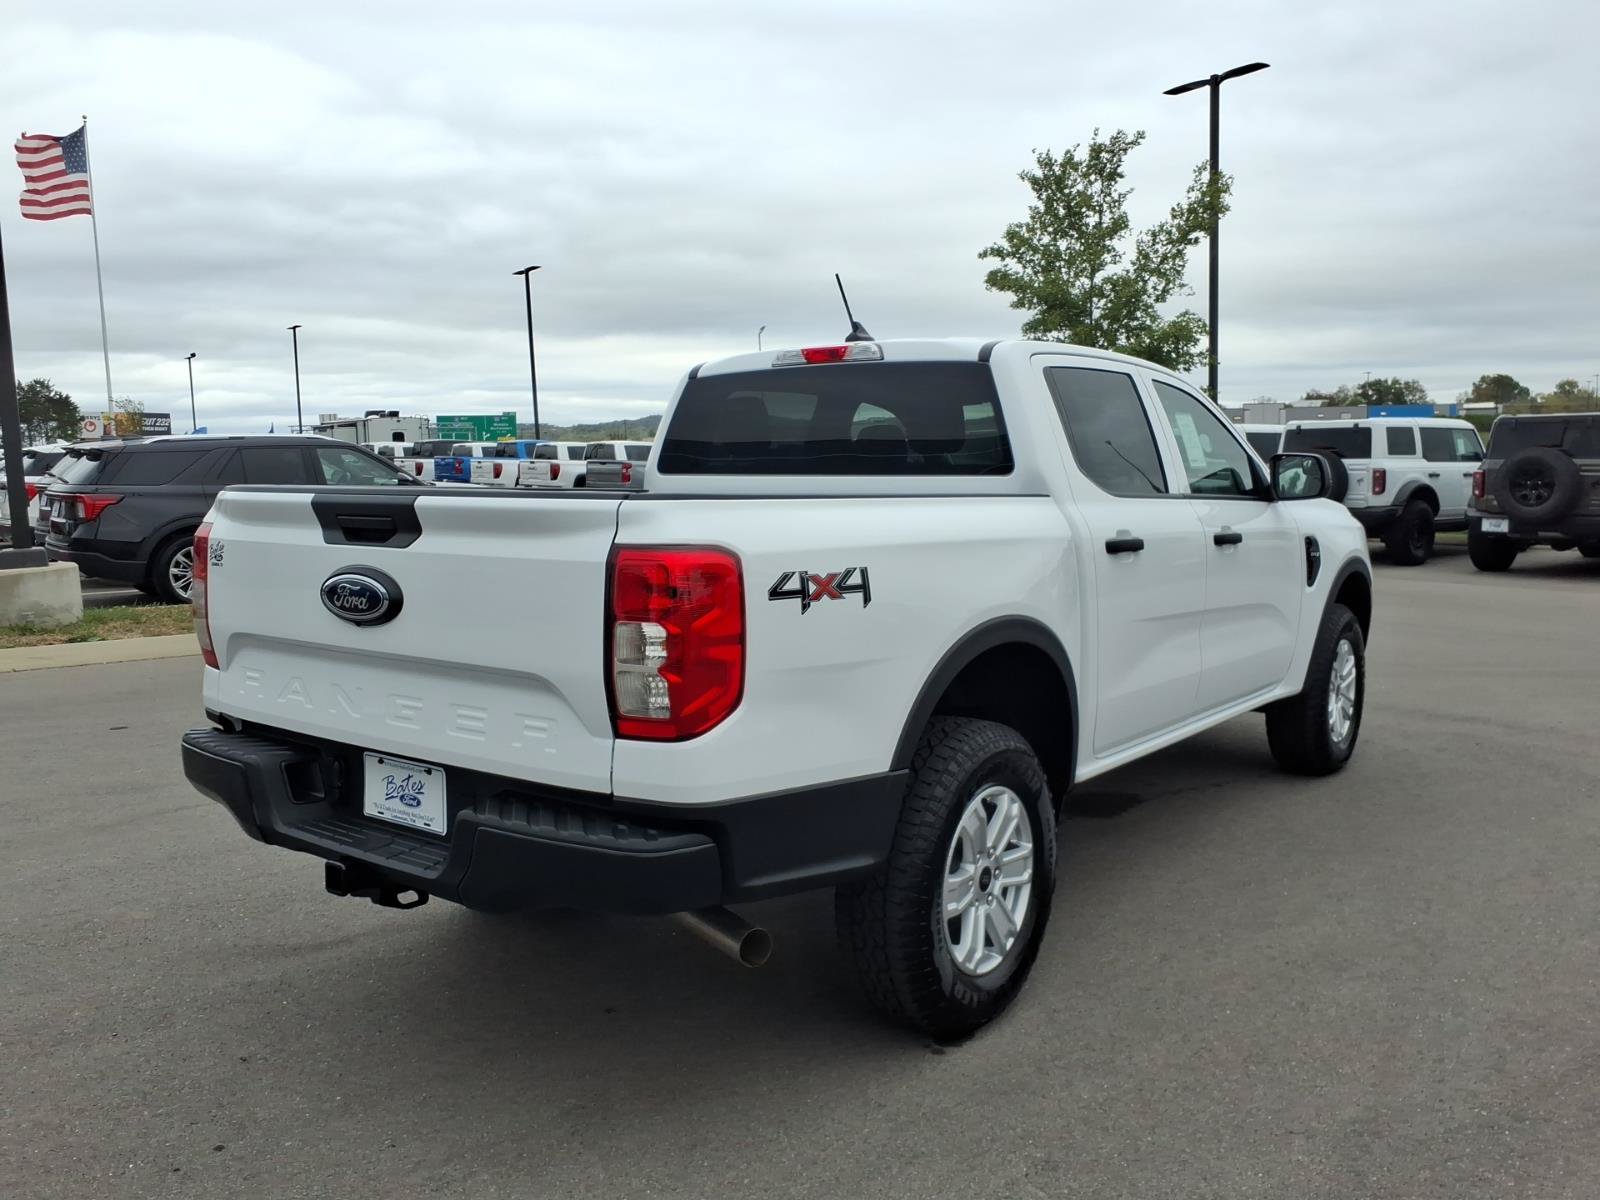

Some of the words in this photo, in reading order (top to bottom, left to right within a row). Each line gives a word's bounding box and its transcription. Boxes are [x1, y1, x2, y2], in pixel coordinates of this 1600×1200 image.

[155, 417, 170, 426] 232
[333, 583, 370, 610] Ford
[240, 666, 558, 753] RANGER
[382, 773, 426, 797] Bates
